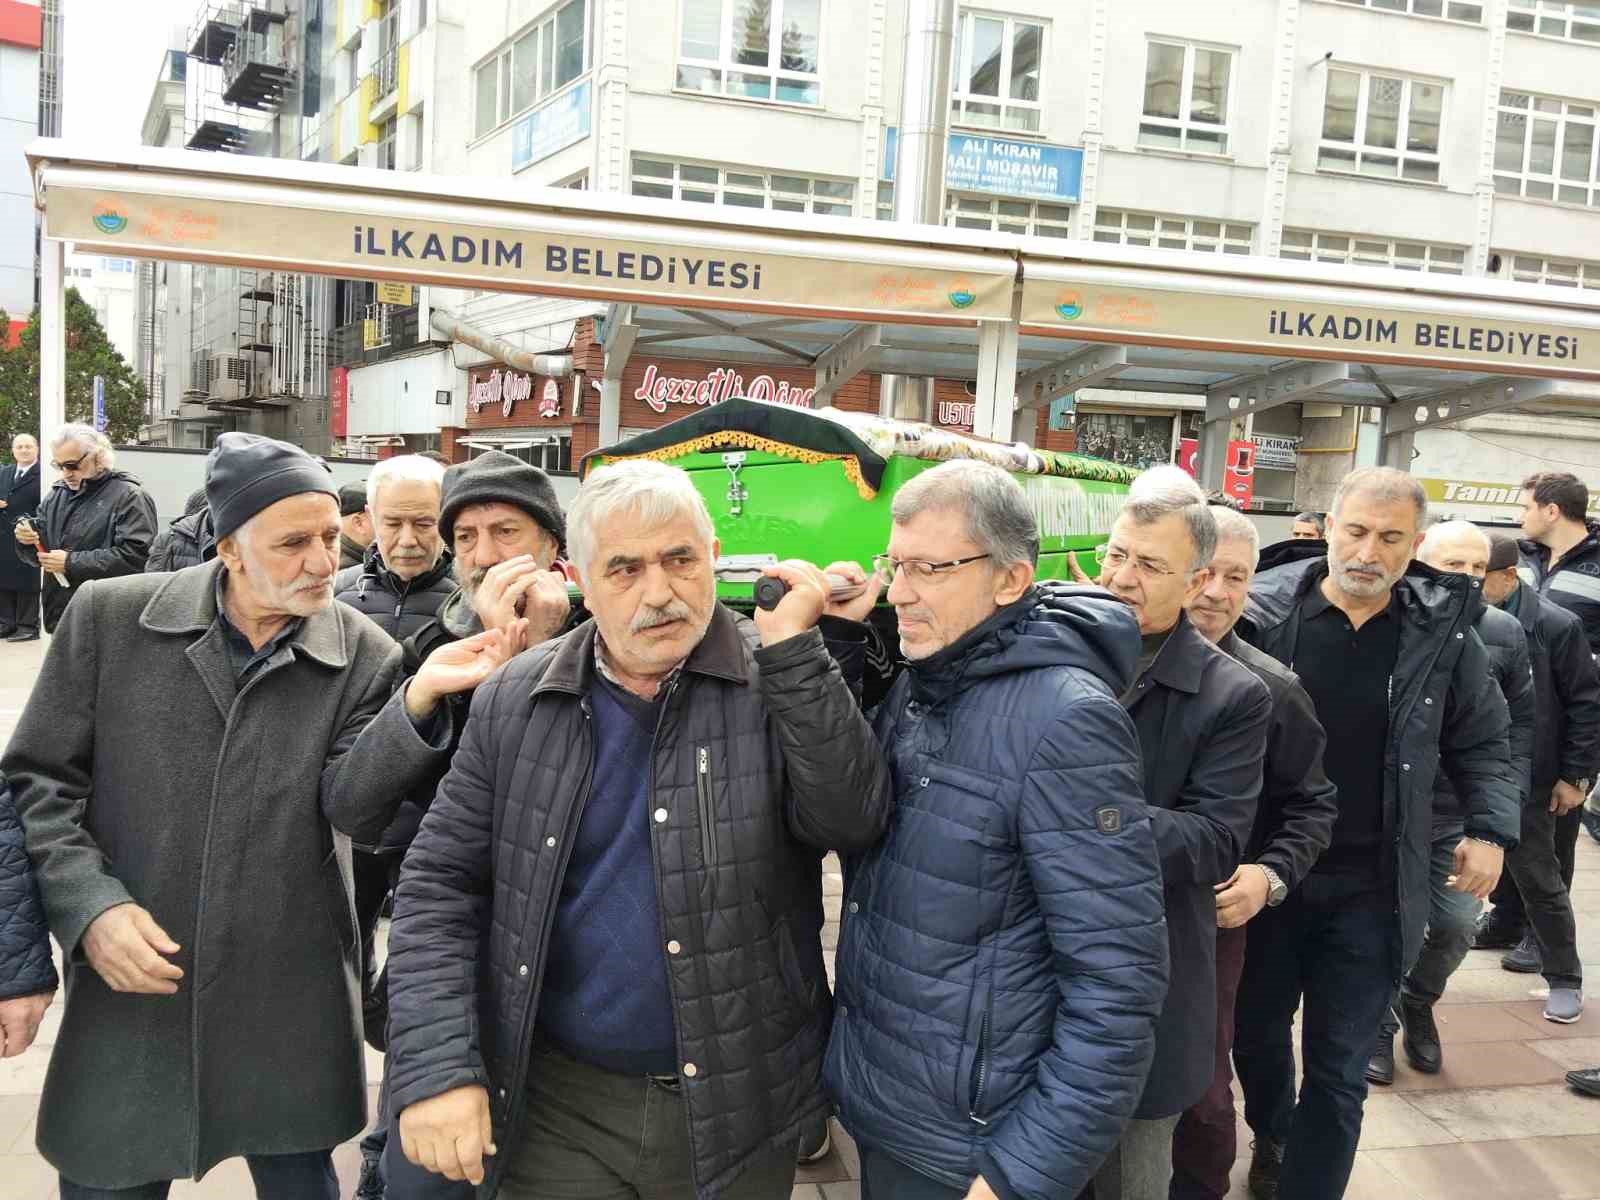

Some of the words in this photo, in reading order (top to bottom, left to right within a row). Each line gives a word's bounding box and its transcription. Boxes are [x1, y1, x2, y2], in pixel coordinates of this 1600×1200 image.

[992, 142, 1041, 160] KIRAN
[634, 365, 744, 412] Lezzetli
[1265, 439, 1296, 450] KIRAN
